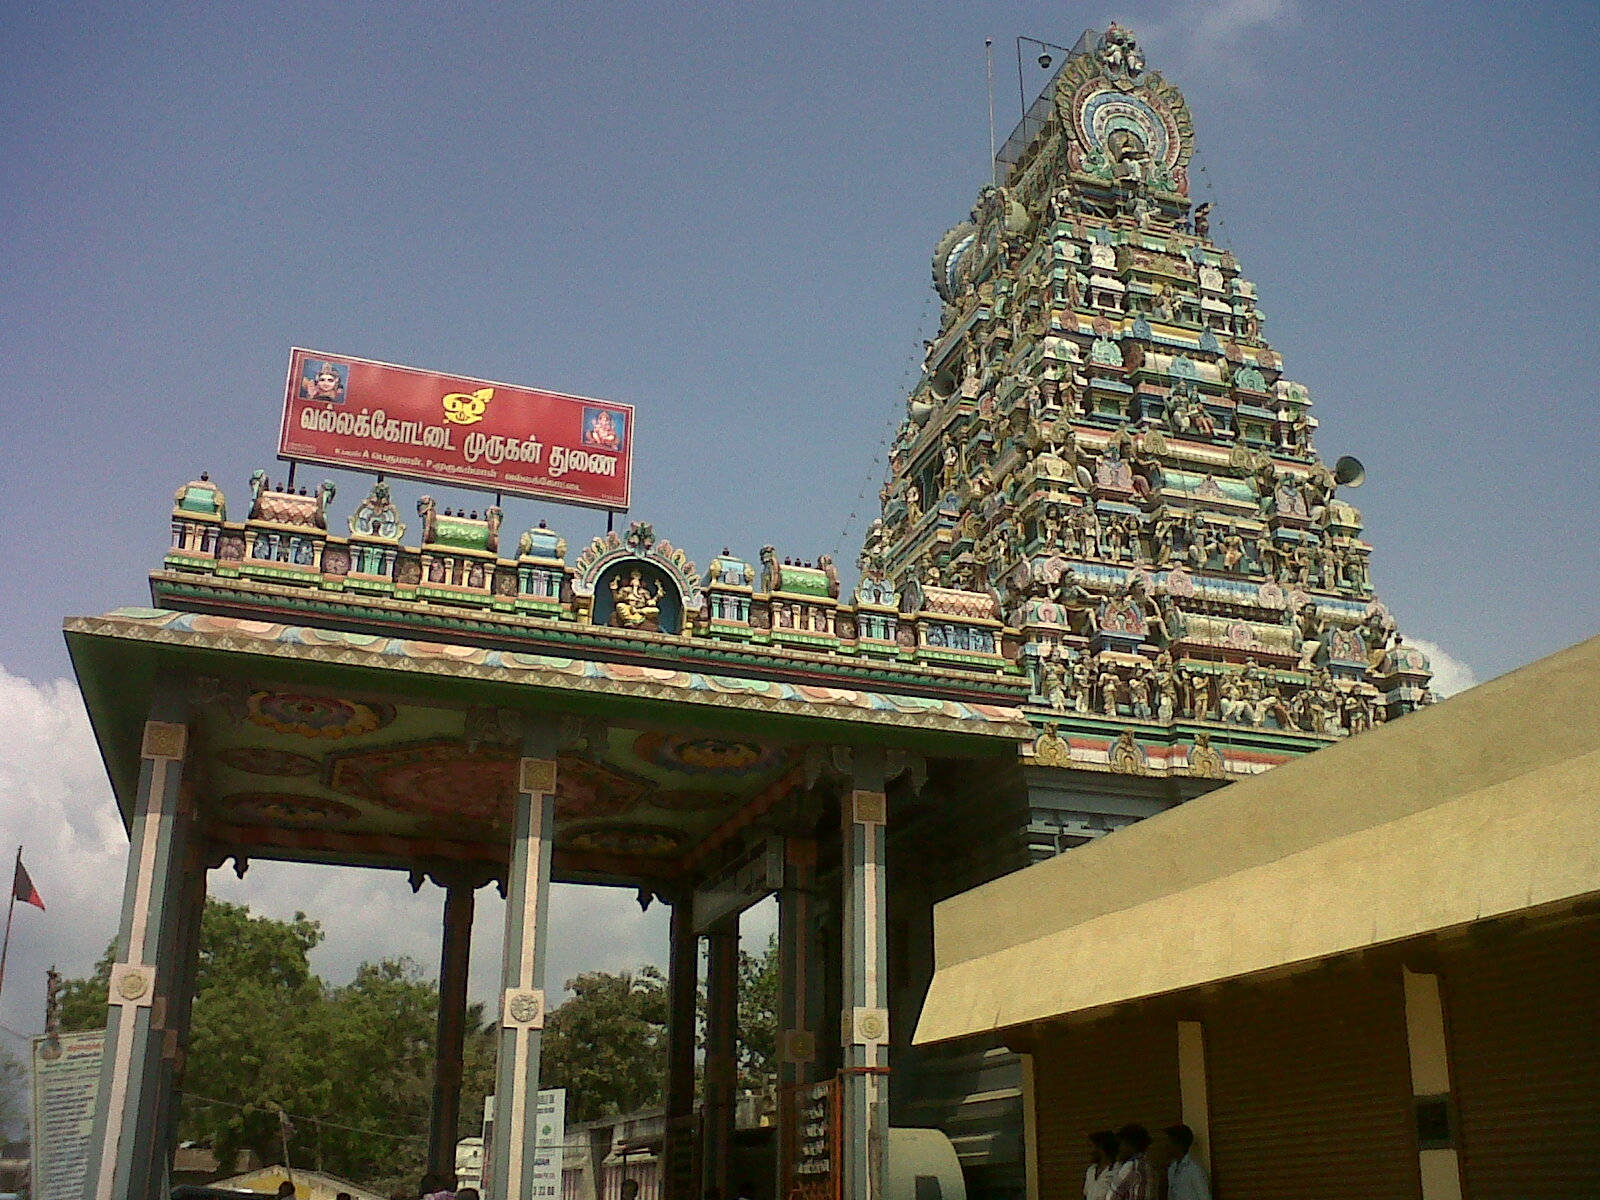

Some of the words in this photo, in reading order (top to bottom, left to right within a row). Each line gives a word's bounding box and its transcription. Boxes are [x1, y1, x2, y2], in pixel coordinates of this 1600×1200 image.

[300, 403, 457, 451] வல்லக்கோட்டை
[463, 432, 544, 465] முருகன்
[548, 446, 618, 477] துணை
